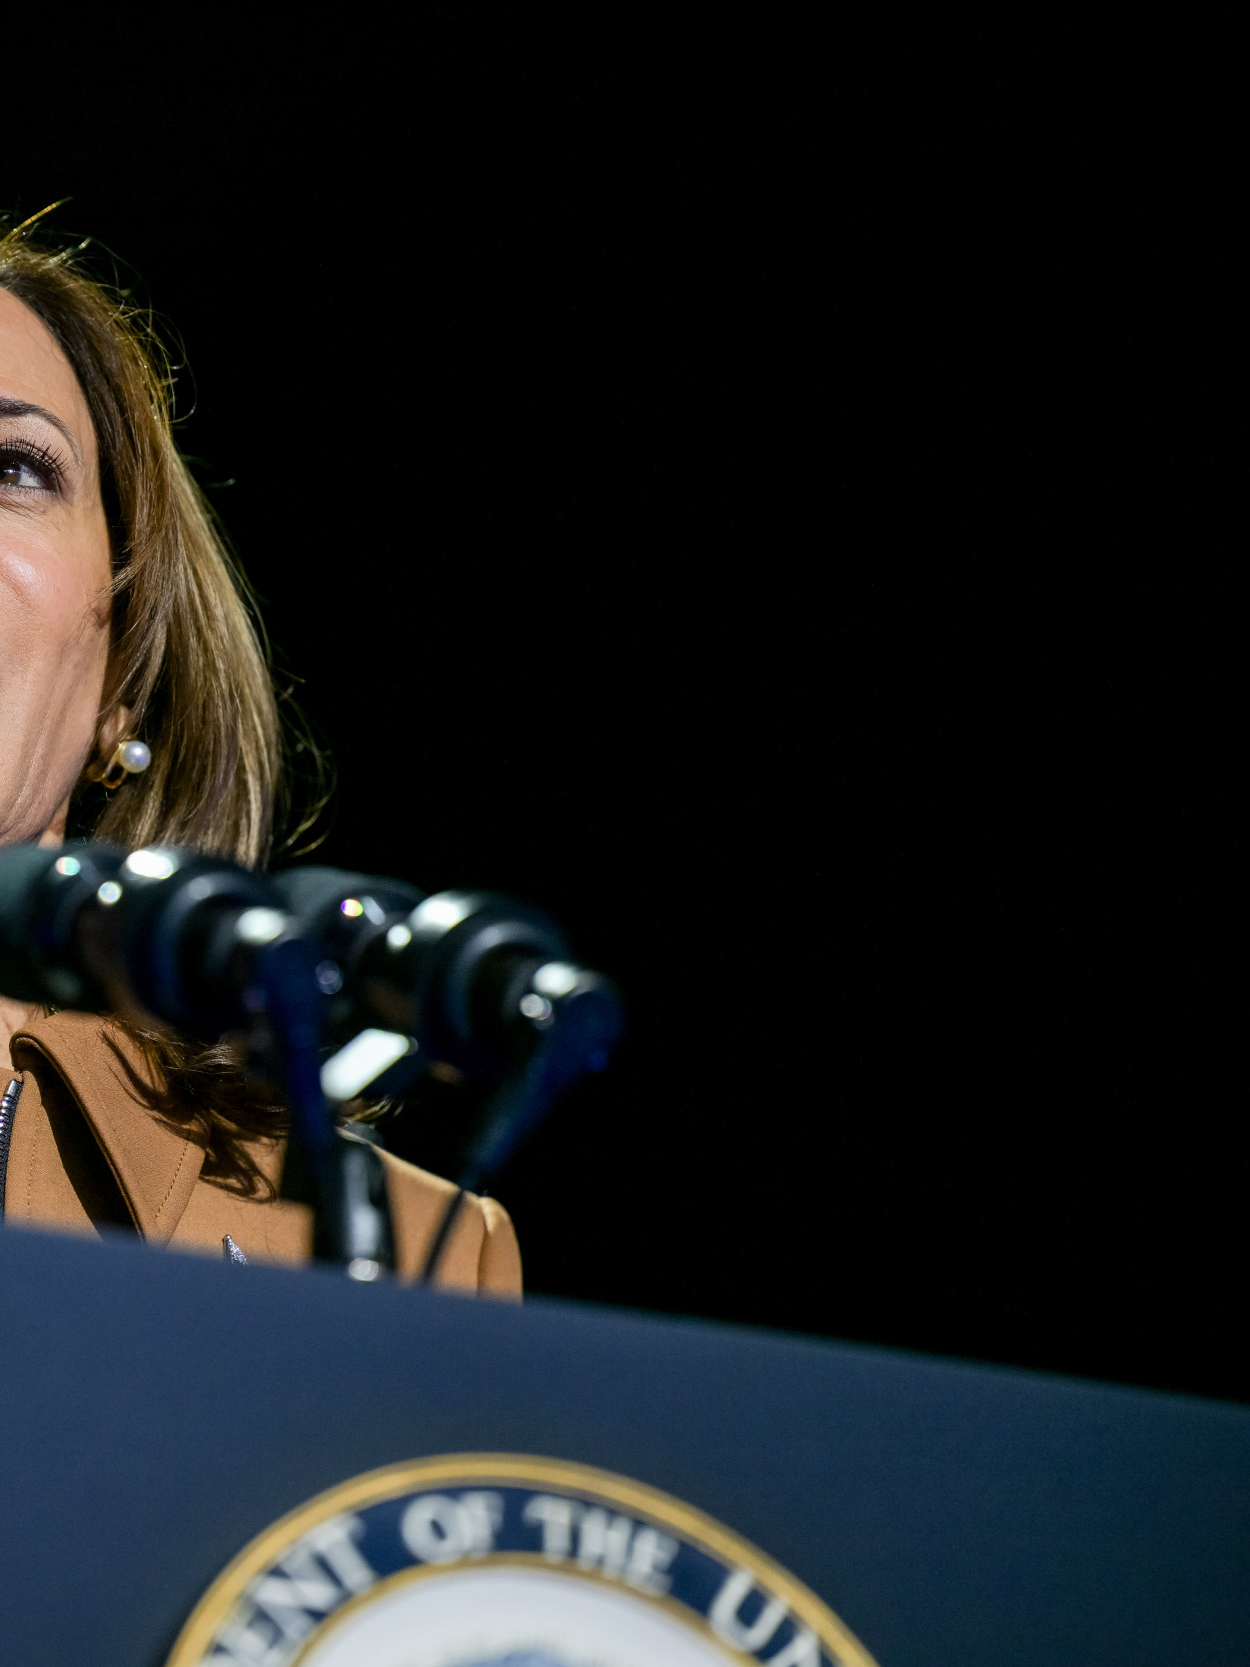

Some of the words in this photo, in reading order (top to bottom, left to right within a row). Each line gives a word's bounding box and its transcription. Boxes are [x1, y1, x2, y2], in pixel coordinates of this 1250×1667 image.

[198, 1512, 376, 1667] ENT
[401, 1490, 504, 1564] OF
[523, 1494, 679, 1597] THE
